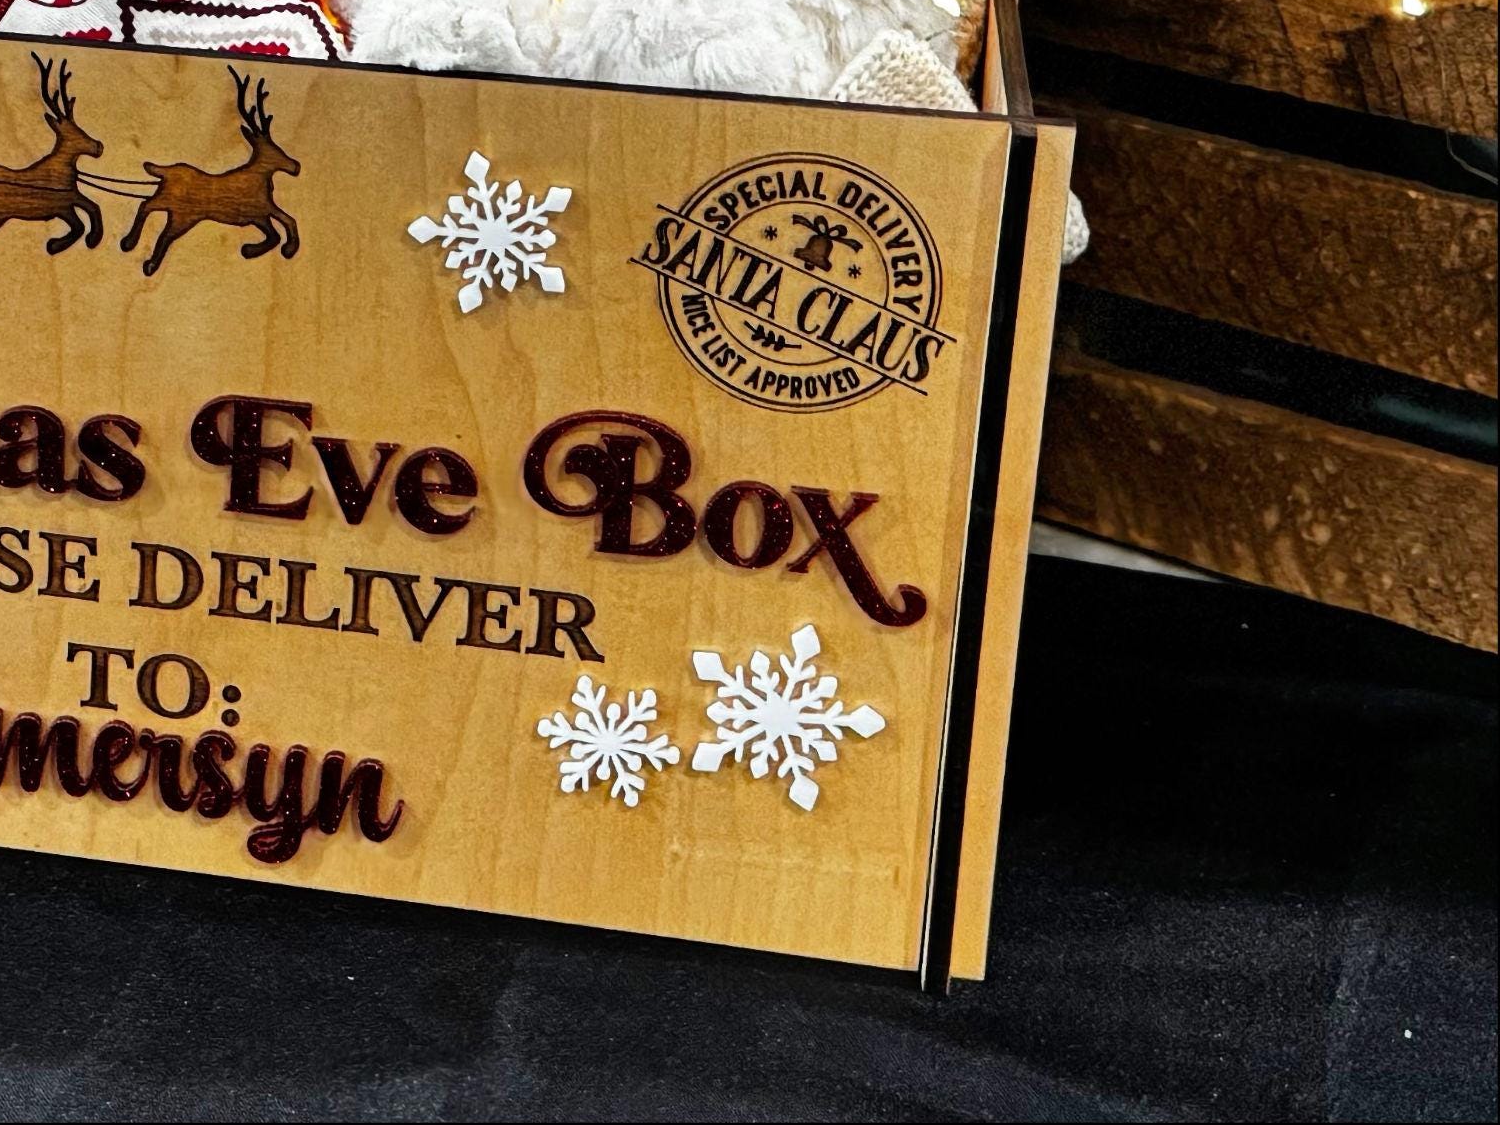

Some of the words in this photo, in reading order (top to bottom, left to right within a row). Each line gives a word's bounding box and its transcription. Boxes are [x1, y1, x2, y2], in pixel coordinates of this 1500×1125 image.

[641, 216, 785, 321] SANTA
[796, 286, 946, 383] CLAUS
[703, 170, 827, 231] SPECIAL
[837, 180, 924, 315] DELIVERY
[680, 293, 715, 339] NICE
[700, 333, 748, 377] LIST
[744, 365, 861, 400] APPROVED
[190, 393, 479, 536] Eve
[522, 409, 928, 628] Box
[128, 542, 606, 664] DELIVER
[65, 641, 242, 727] TO:
